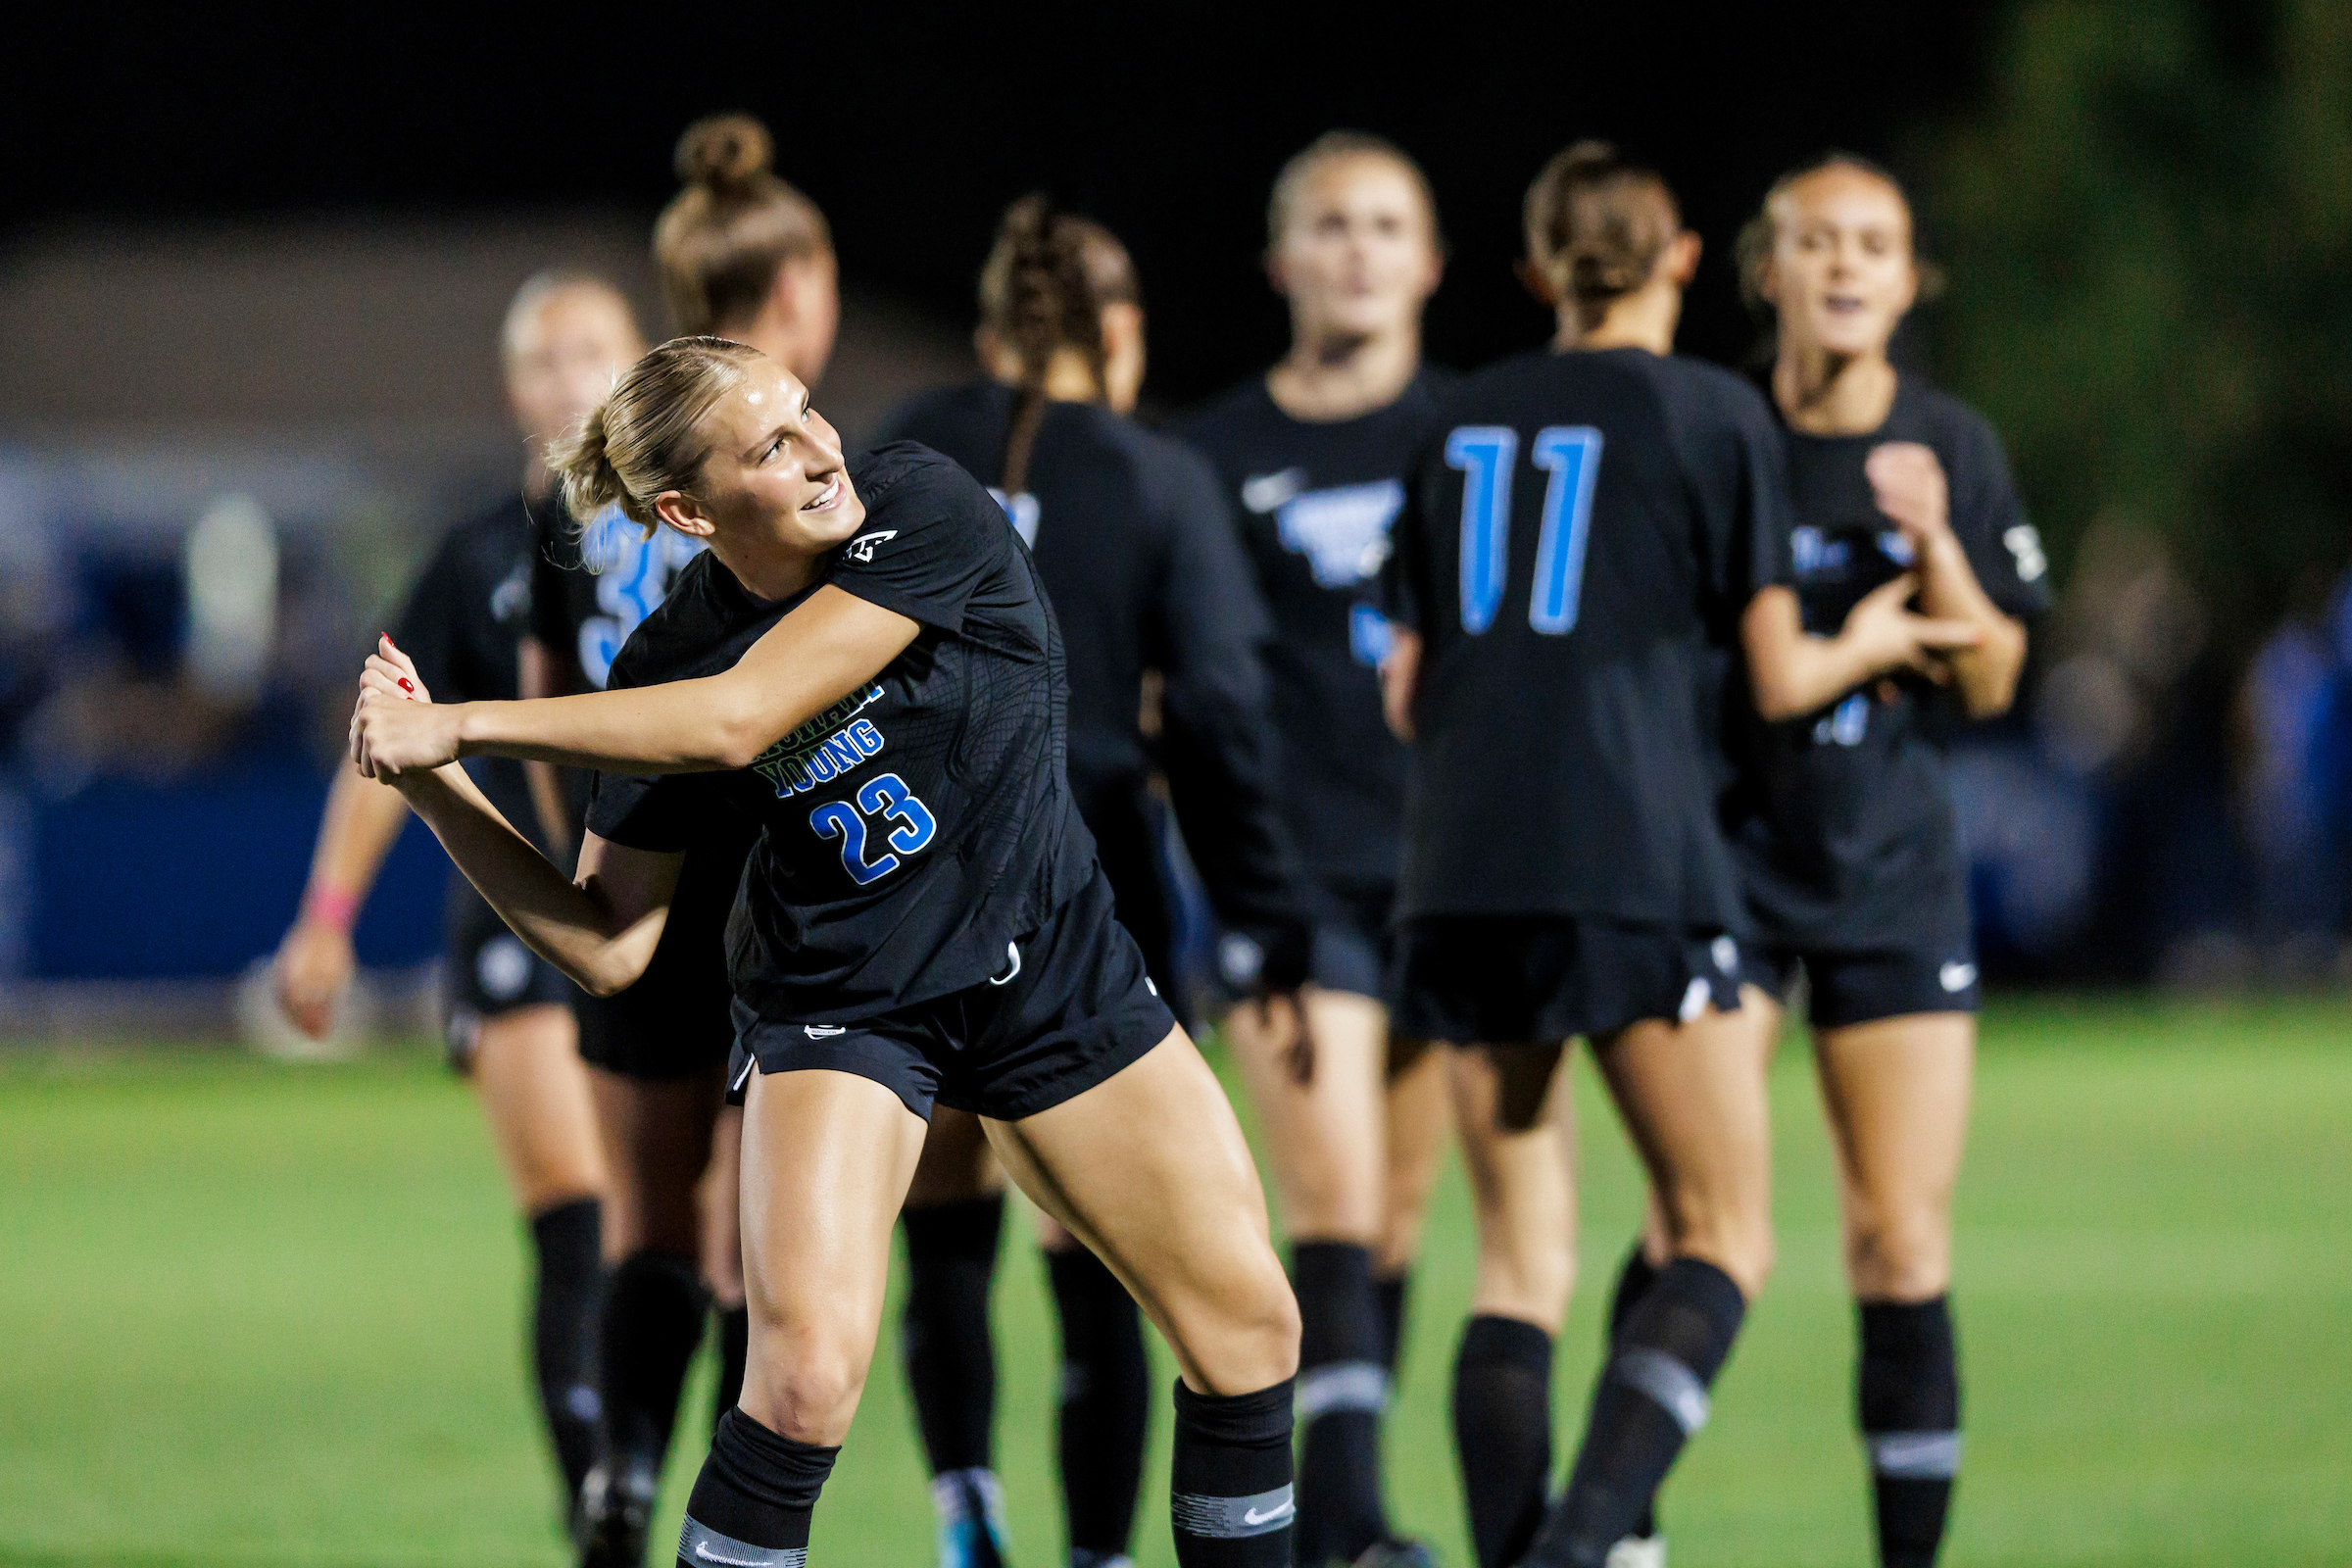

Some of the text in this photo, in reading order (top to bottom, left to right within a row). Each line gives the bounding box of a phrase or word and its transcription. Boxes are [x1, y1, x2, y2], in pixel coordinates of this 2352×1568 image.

[1445, 425, 1604, 635] 11
[754, 718, 885, 799] YOUNG
[809, 773, 937, 885] 23
